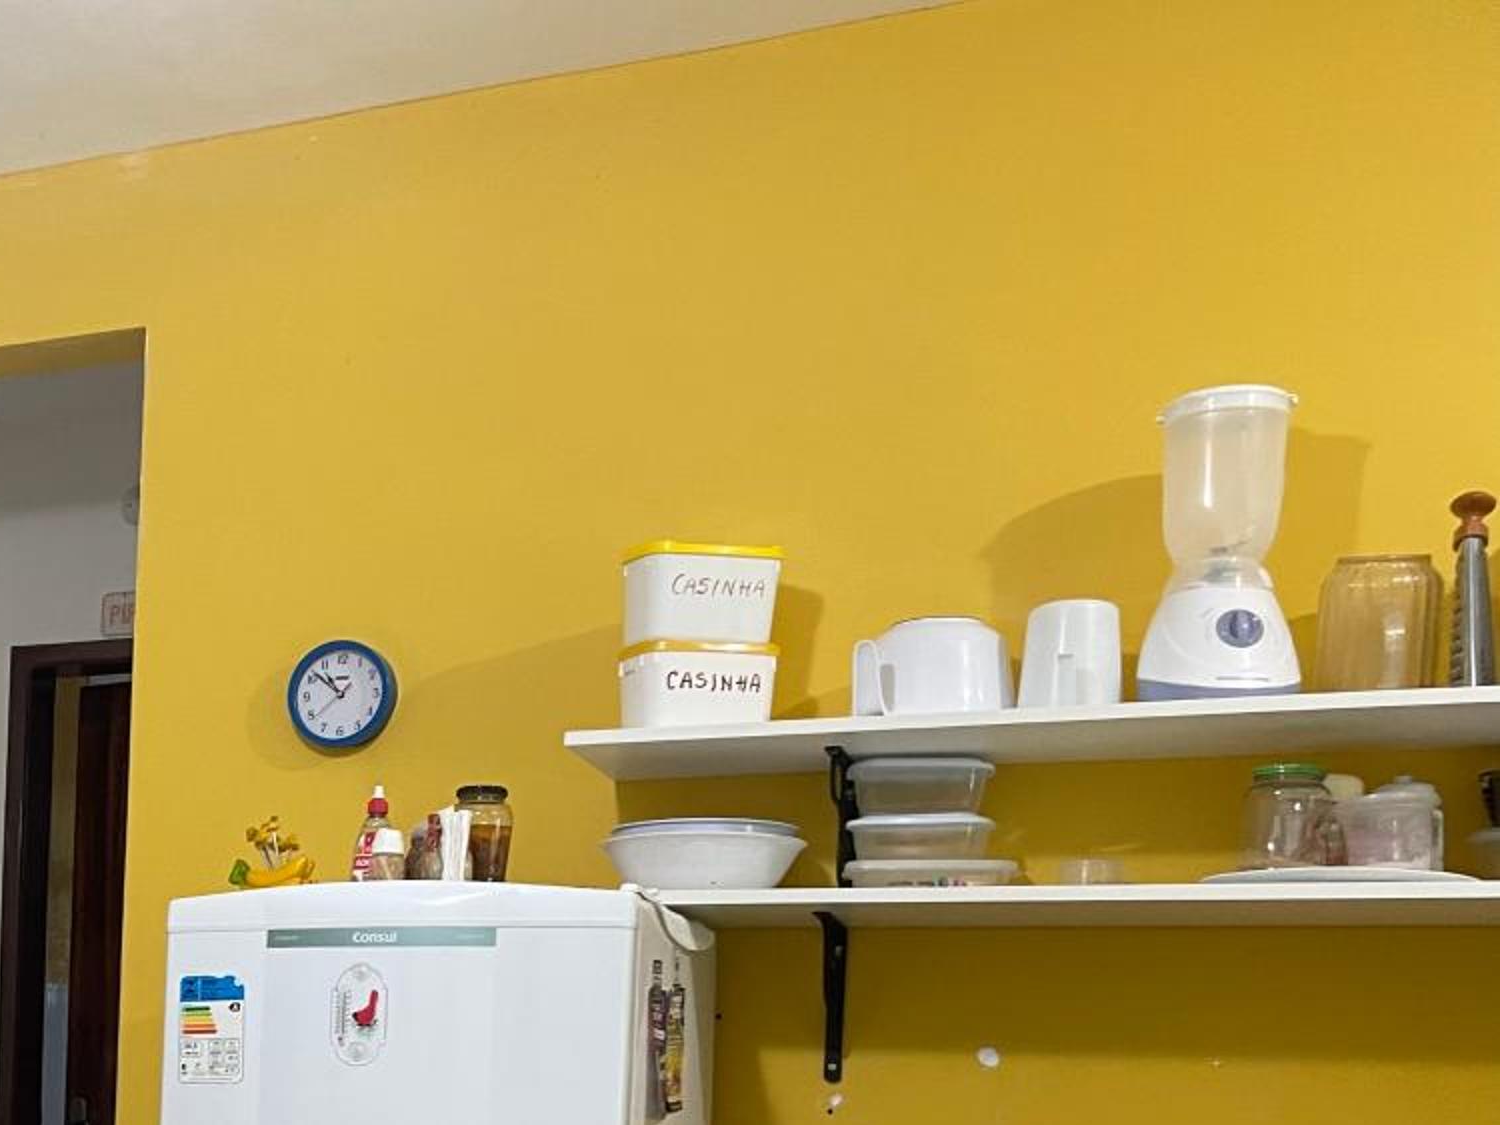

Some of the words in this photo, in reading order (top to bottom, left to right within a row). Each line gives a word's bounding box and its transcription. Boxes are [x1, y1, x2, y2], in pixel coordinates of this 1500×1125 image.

[671, 573, 766, 598] CASINHA
[666, 670, 762, 693] CASINHA
[352, 931, 398, 944] Consul
